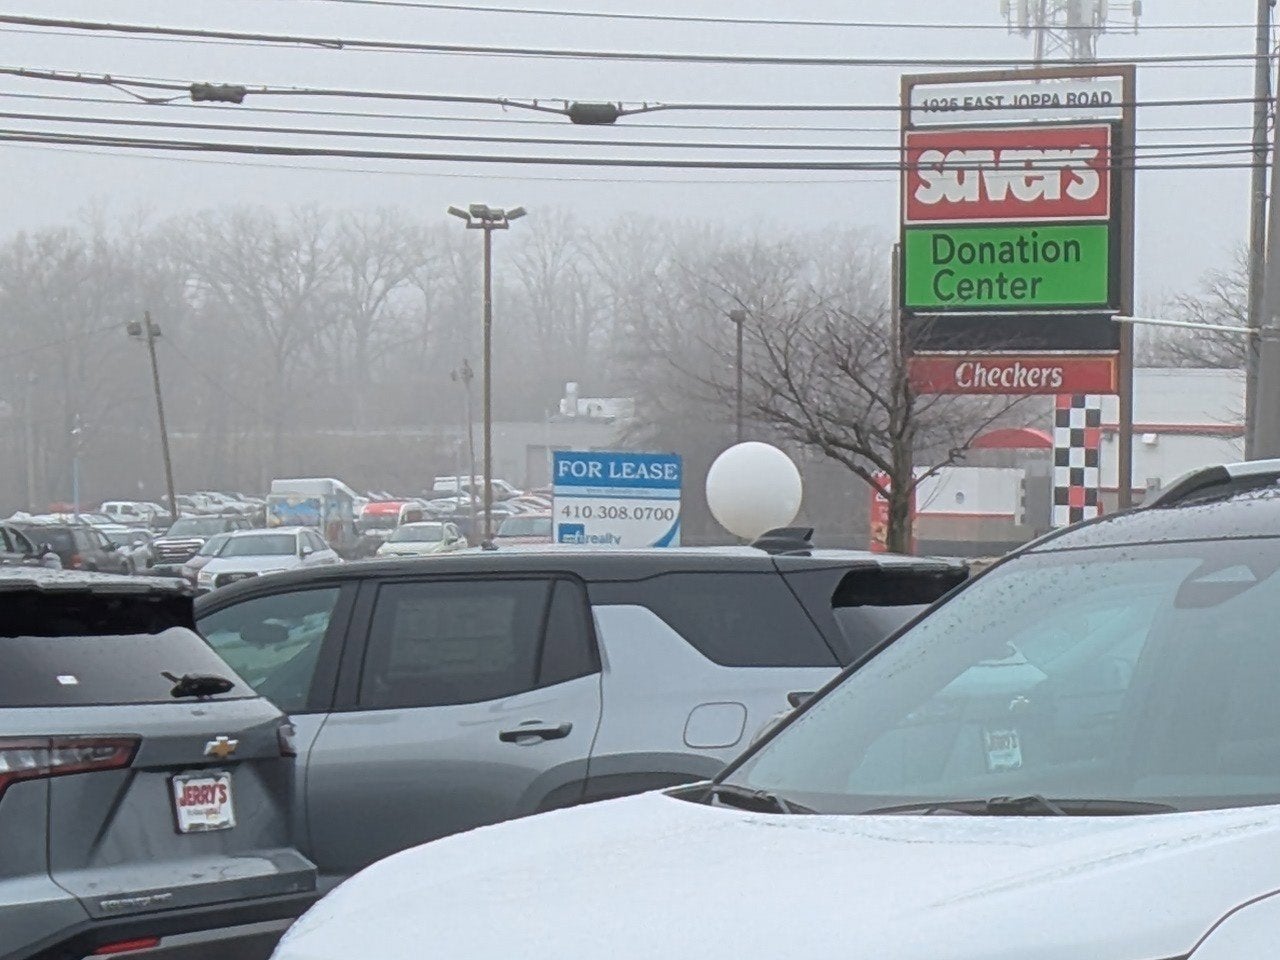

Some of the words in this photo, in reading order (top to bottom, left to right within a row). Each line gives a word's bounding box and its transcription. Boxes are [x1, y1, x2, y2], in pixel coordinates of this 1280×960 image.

[963, 95, 1005, 110] EAST
[1009, 92, 1061, 108] JOPPA
[1066, 90, 1113, 106] ROAD
[931, 230, 1081, 266] Donation
[932, 268, 1043, 301] Center
[955, 362, 1063, 388] Checkers
[558, 460, 602, 478] FOR
[609, 461, 678, 480] LEASE
[561, 505, 675, 521] 410.308.0700
[180, 783, 227, 807] JERRY'S
